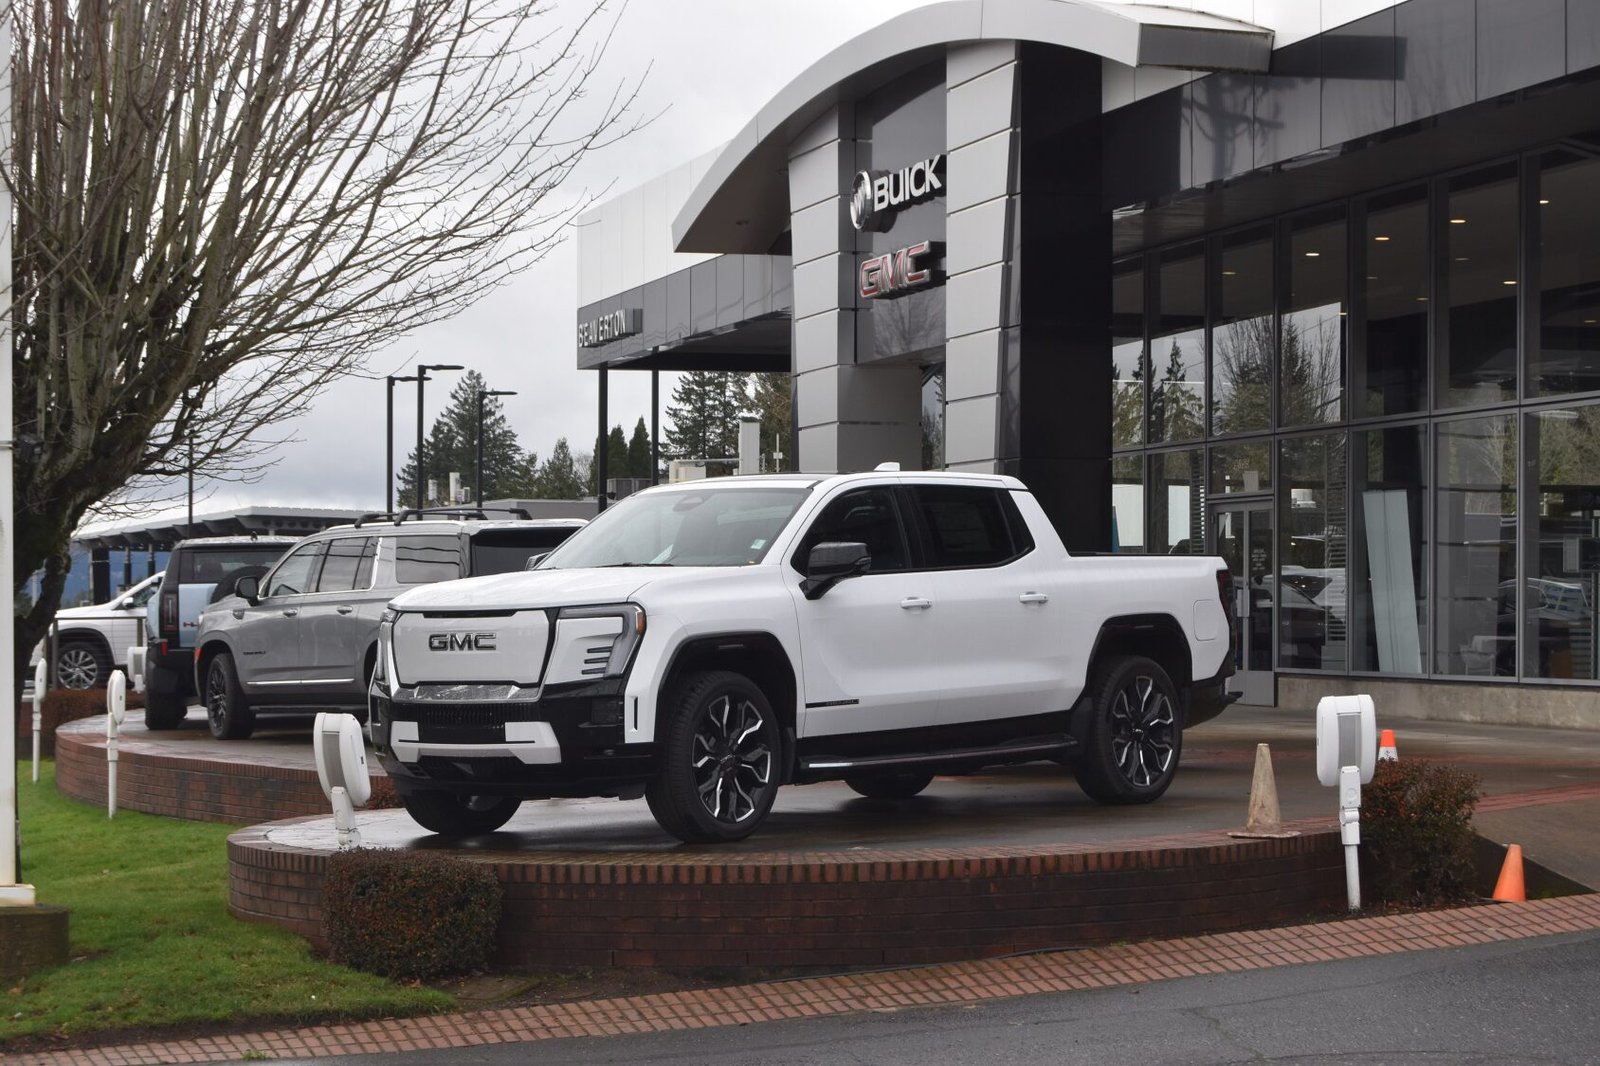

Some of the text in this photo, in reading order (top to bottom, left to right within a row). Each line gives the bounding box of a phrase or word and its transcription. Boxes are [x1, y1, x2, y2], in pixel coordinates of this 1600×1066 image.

[873, 154, 942, 212] BUICK
[859, 240, 930, 298] GMC
[578, 308, 626, 348] BEAVERTON
[428, 632, 497, 651] GMC
